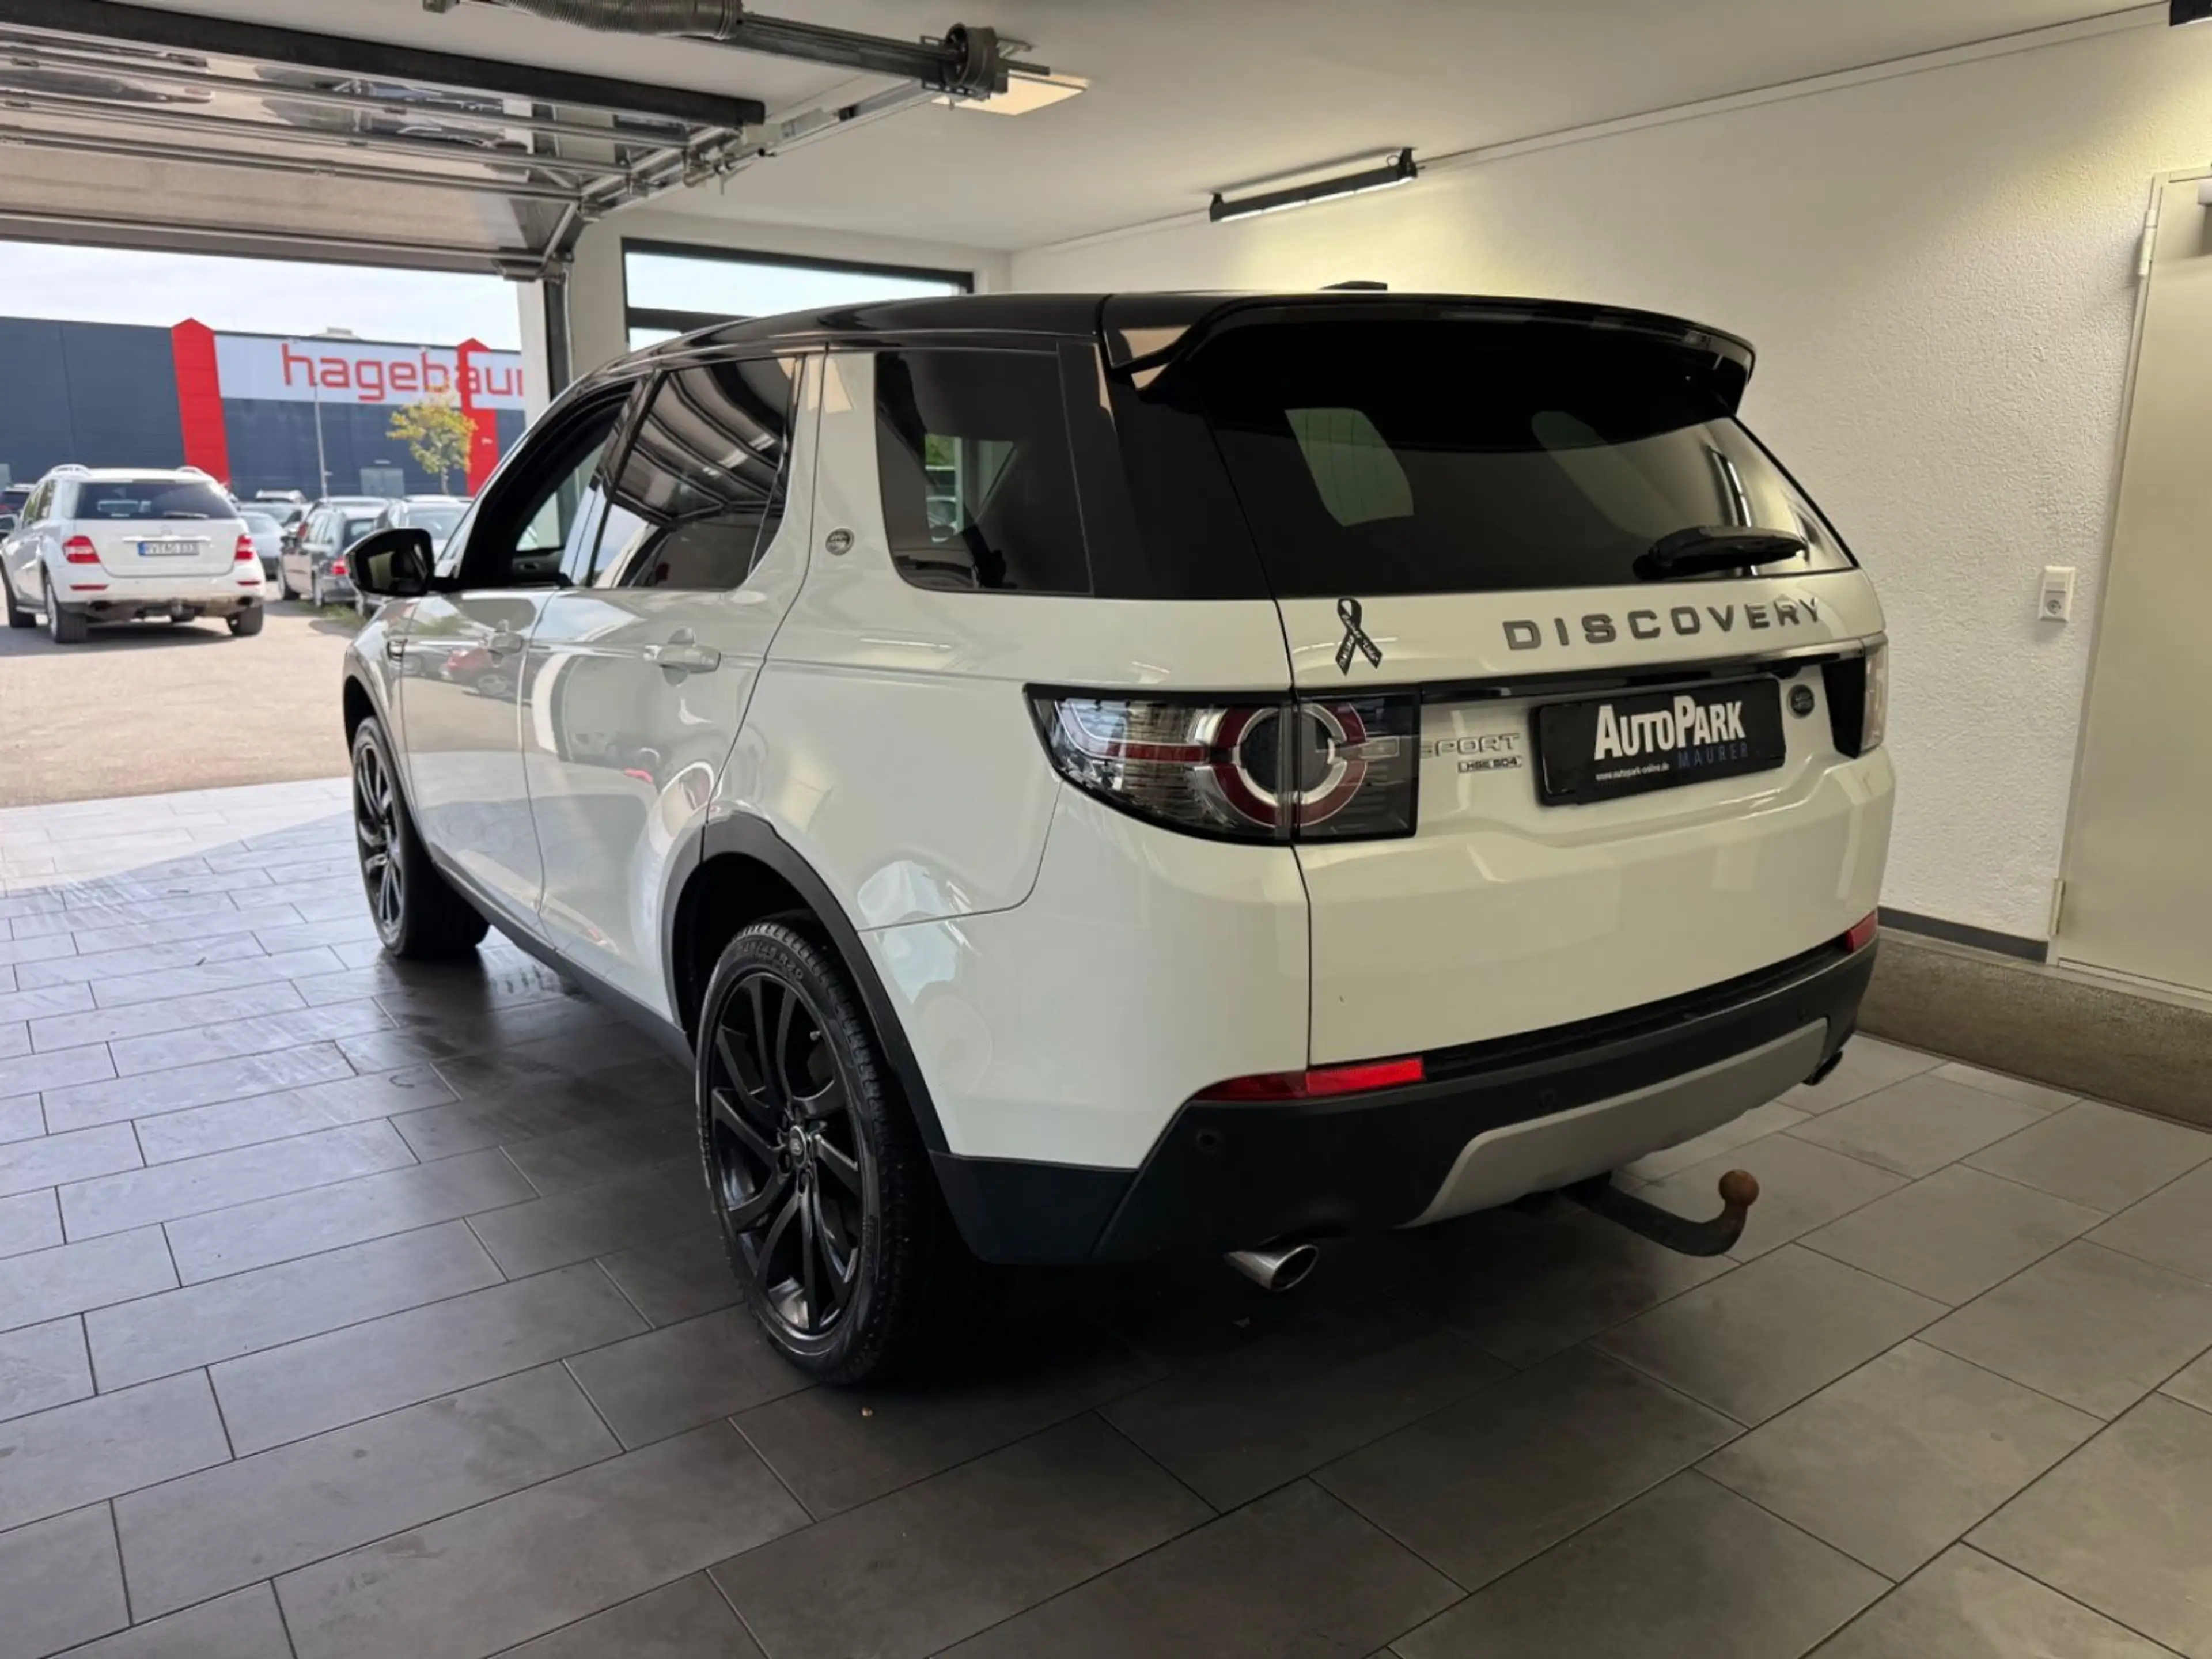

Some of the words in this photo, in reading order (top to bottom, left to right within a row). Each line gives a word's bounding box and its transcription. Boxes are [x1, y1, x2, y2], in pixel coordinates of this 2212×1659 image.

[282, 343, 523, 402] hagebau
[1502, 597, 1819, 650] DISCOVERY
[1677, 742, 1748, 769] MAURER
